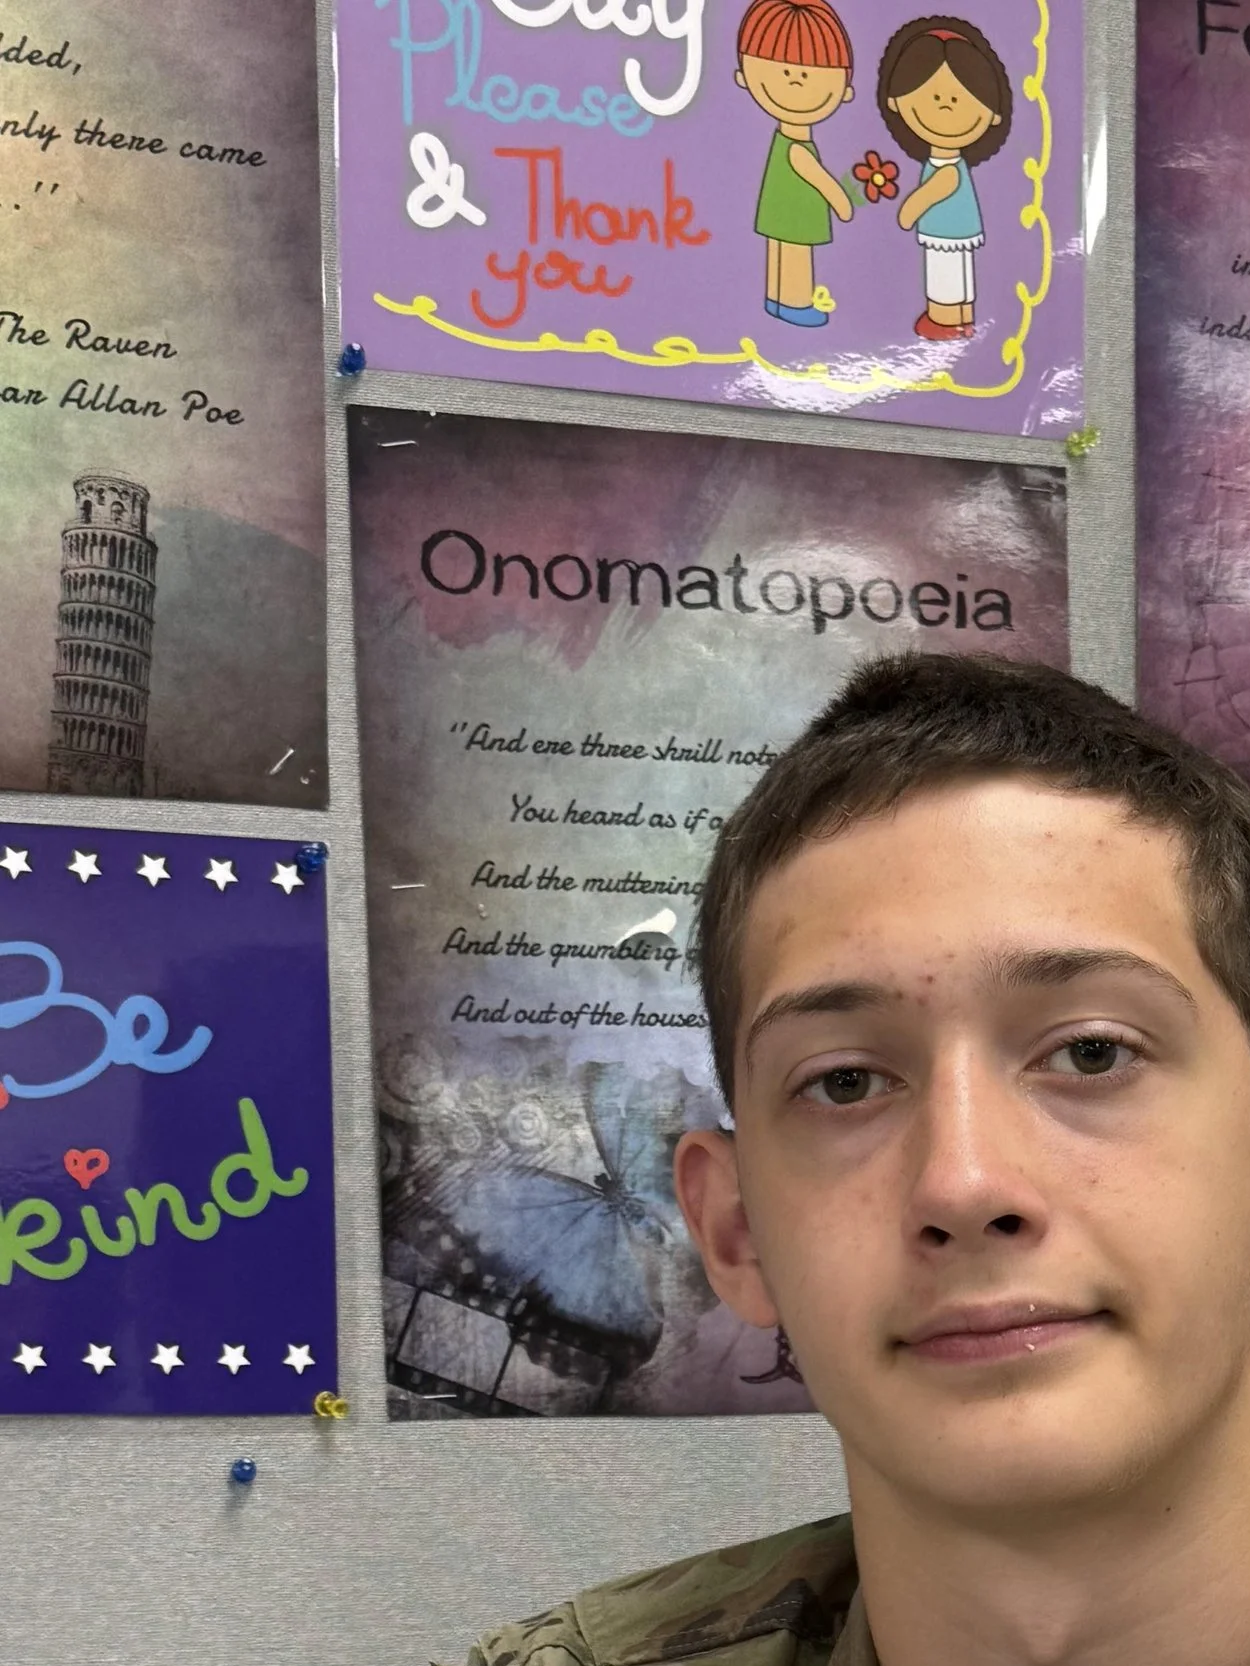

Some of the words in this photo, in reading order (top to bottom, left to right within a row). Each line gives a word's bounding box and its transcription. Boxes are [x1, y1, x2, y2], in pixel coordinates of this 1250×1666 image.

[0, 32, 81, 75] ded,
[374, 0, 654, 137] Please
[0, 110, 61, 152] nly
[74, 118, 168, 155] there
[179, 140, 267, 167] came
[406, 132, 486, 228] &
[495, 146, 710, 249] Thank
[472, 248, 632, 328] you
[64, 318, 177, 359] Raven
[0, 386, 48, 405] ar
[59, 378, 167, 419] Allan
[181, 390, 245, 426] Poe
[420, 529, 1016, 635] Onomatopoeia
[531, 736, 575, 757] ere
[580, 731, 649, 761] three
[652, 736, 723, 763] shrill
[509, 793, 558, 824] You
[562, 798, 644, 830] heard
[648, 813, 677, 828] as
[683, 808, 709, 834] if
[709, 816, 724, 830] a
[470, 860, 533, 891] And
[536, 865, 578, 891] the
[582, 871, 706, 906] muttering
[441, 926, 504, 958] And
[504, 931, 546, 959] the
[550, 940, 682, 971] grumbling
[0, 941, 213, 1098] Be
[451, 994, 514, 1025] And
[514, 1002, 559, 1026] out
[558, 1001, 591, 1029] of
[589, 1001, 627, 1026] the
[631, 1002, 709, 1028] houses
[0, 1098, 308, 1284] kind
